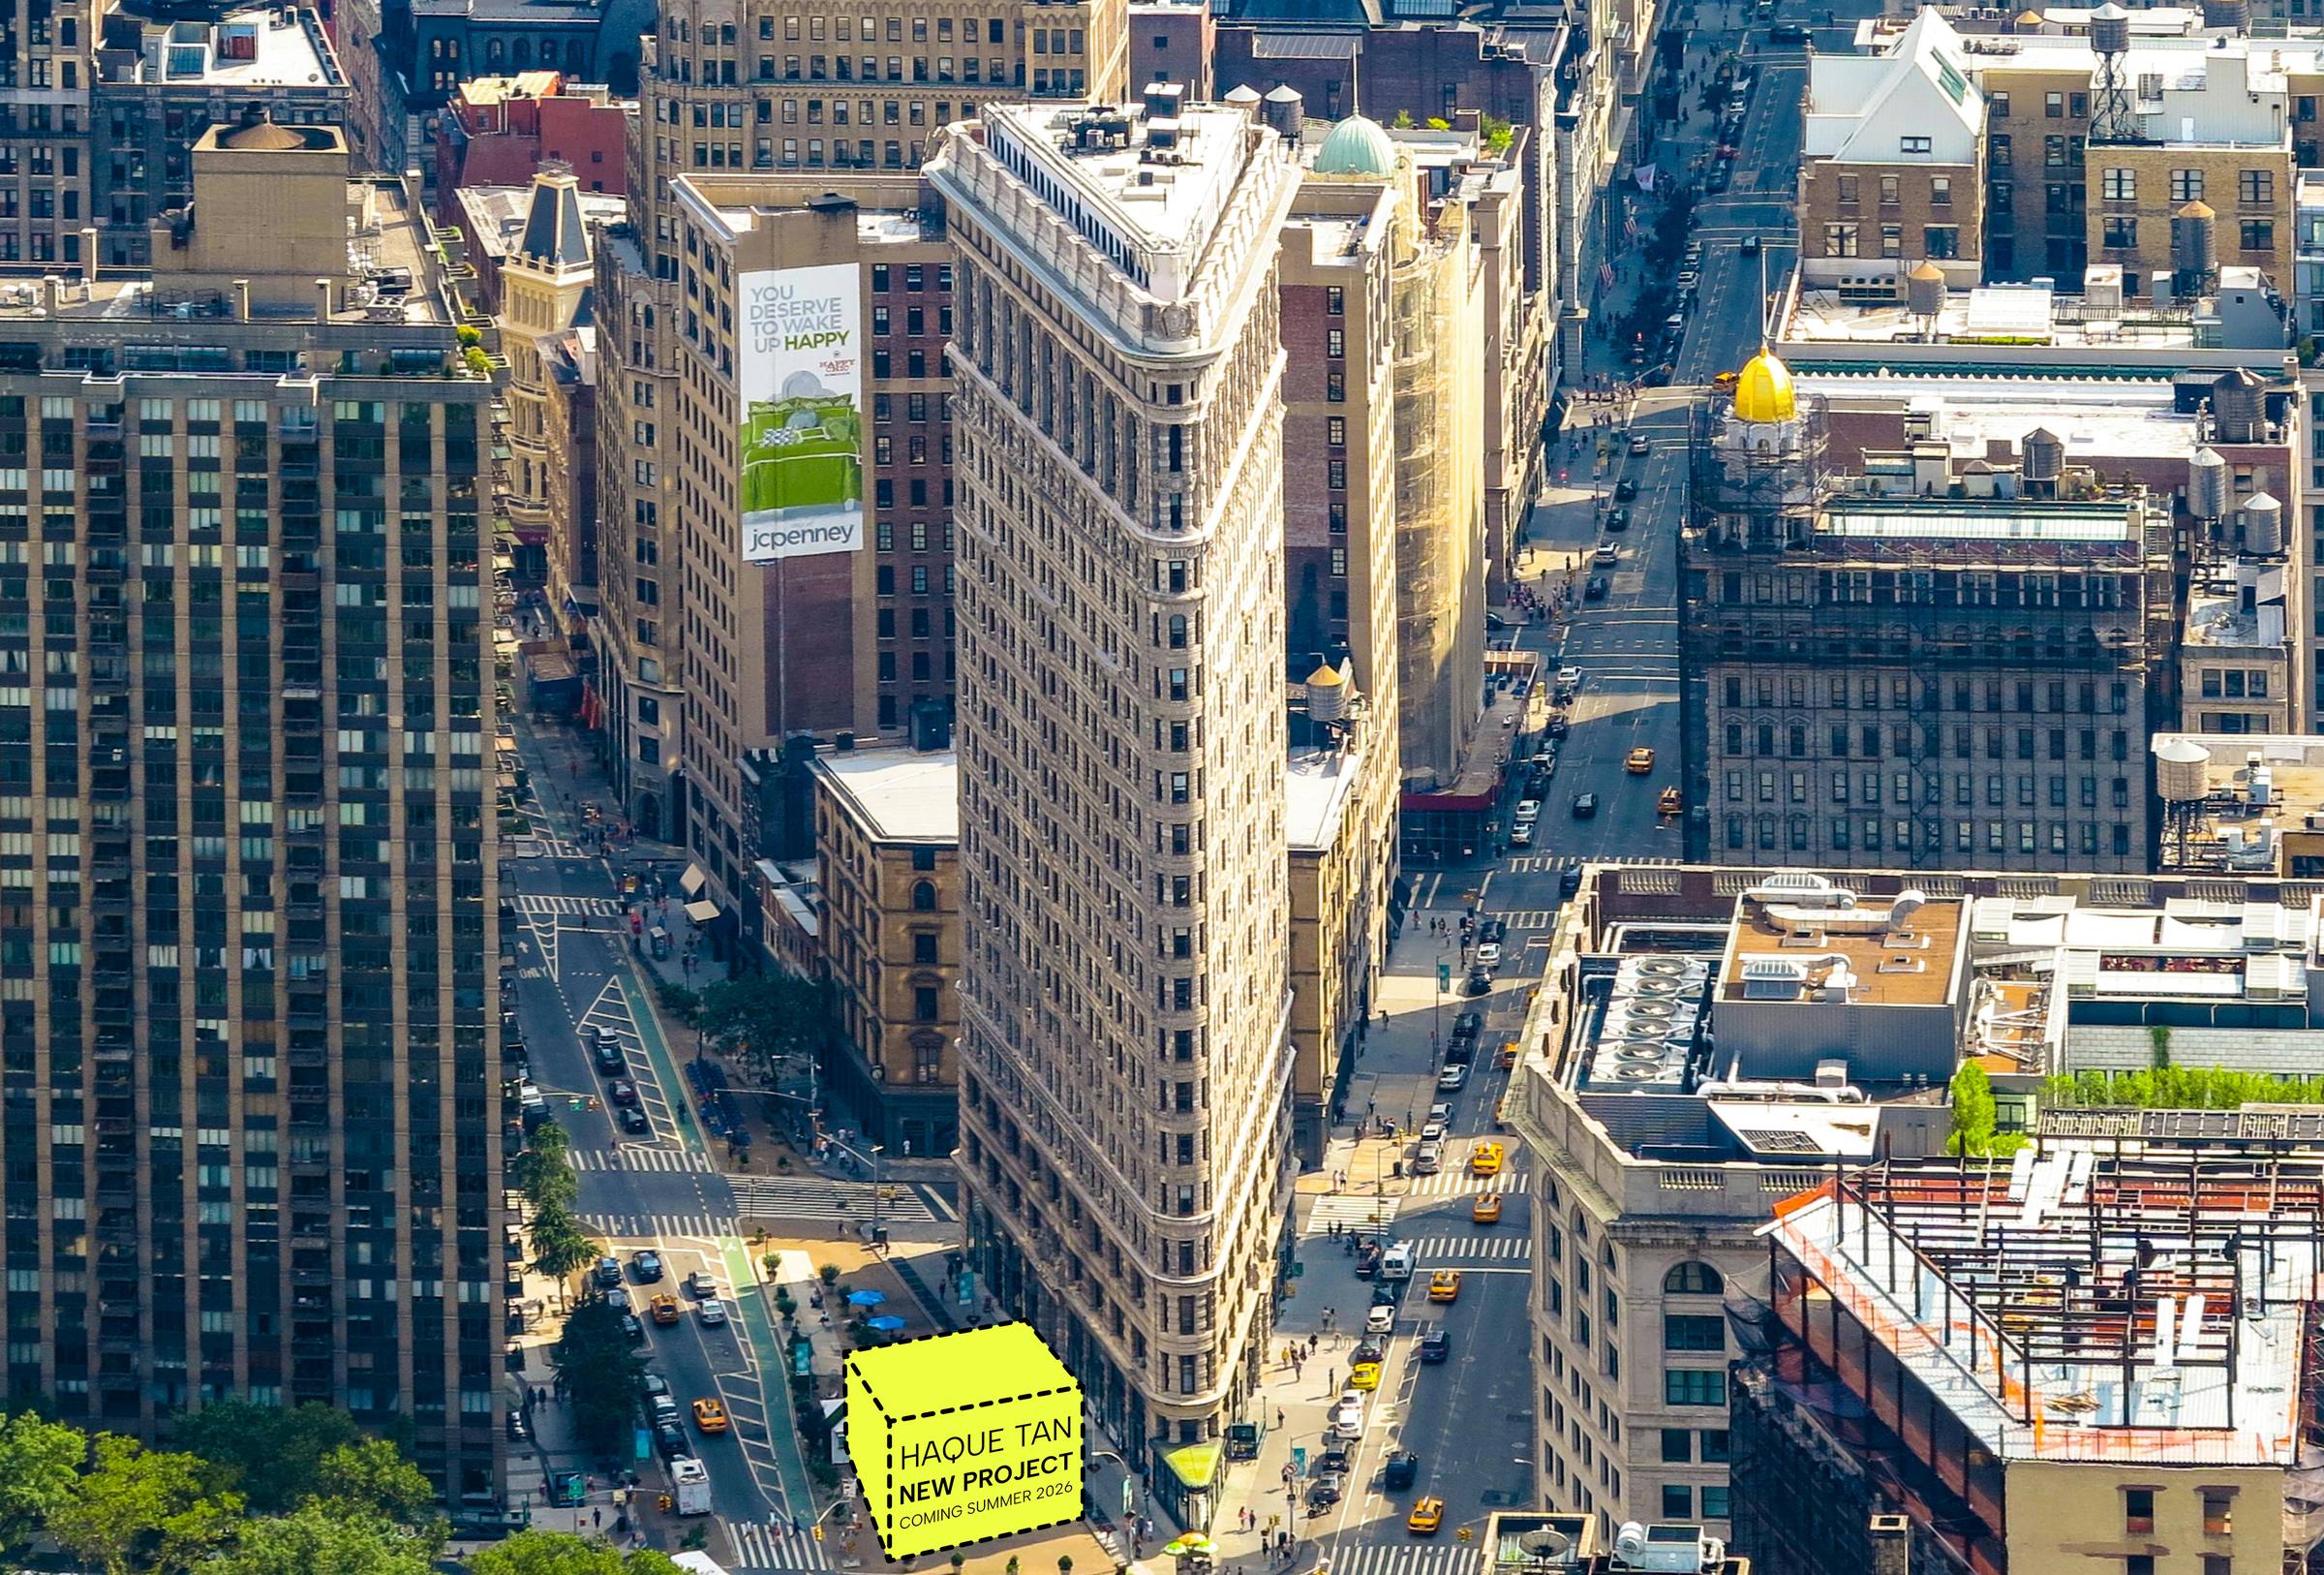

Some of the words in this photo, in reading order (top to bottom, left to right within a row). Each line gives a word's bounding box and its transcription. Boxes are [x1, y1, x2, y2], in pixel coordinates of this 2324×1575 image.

[749, 285, 794, 303] YOU
[749, 297, 841, 320] DESERVE
[750, 321, 779, 337] TO
[782, 314, 842, 333] WAKE
[754, 337, 780, 354] UP
[784, 330, 850, 352] HAPPY
[749, 524, 854, 552] jcpenney
